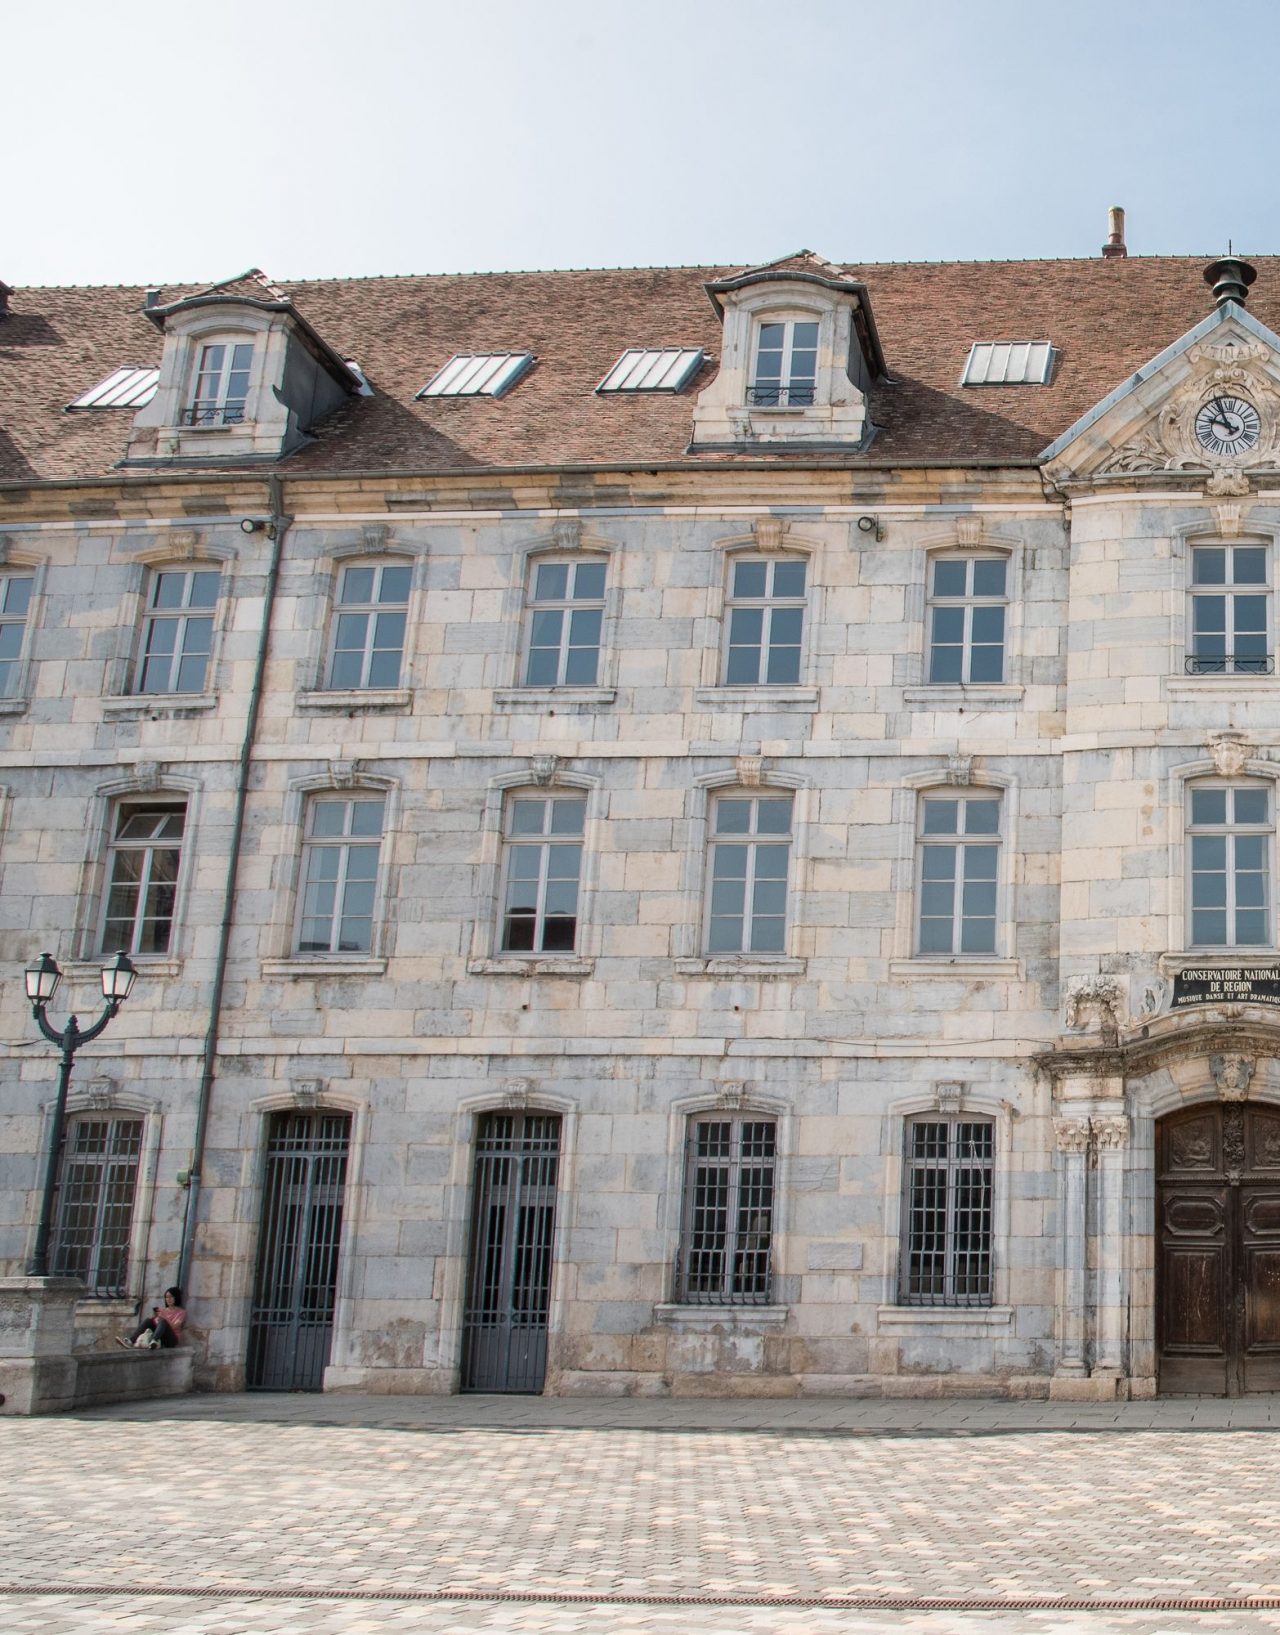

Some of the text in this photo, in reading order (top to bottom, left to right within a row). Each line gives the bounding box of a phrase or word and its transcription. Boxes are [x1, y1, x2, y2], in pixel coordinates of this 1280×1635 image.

[1182, 970, 1280, 981] CONSERVATOIRE NATIONAL
[1210, 981, 1252, 992] DE REGION
[1178, 994, 1203, 1004] MUSIQUE
[1205, 993, 1225, 1001] DANSE
[1227, 992, 1234, 1000] ET
